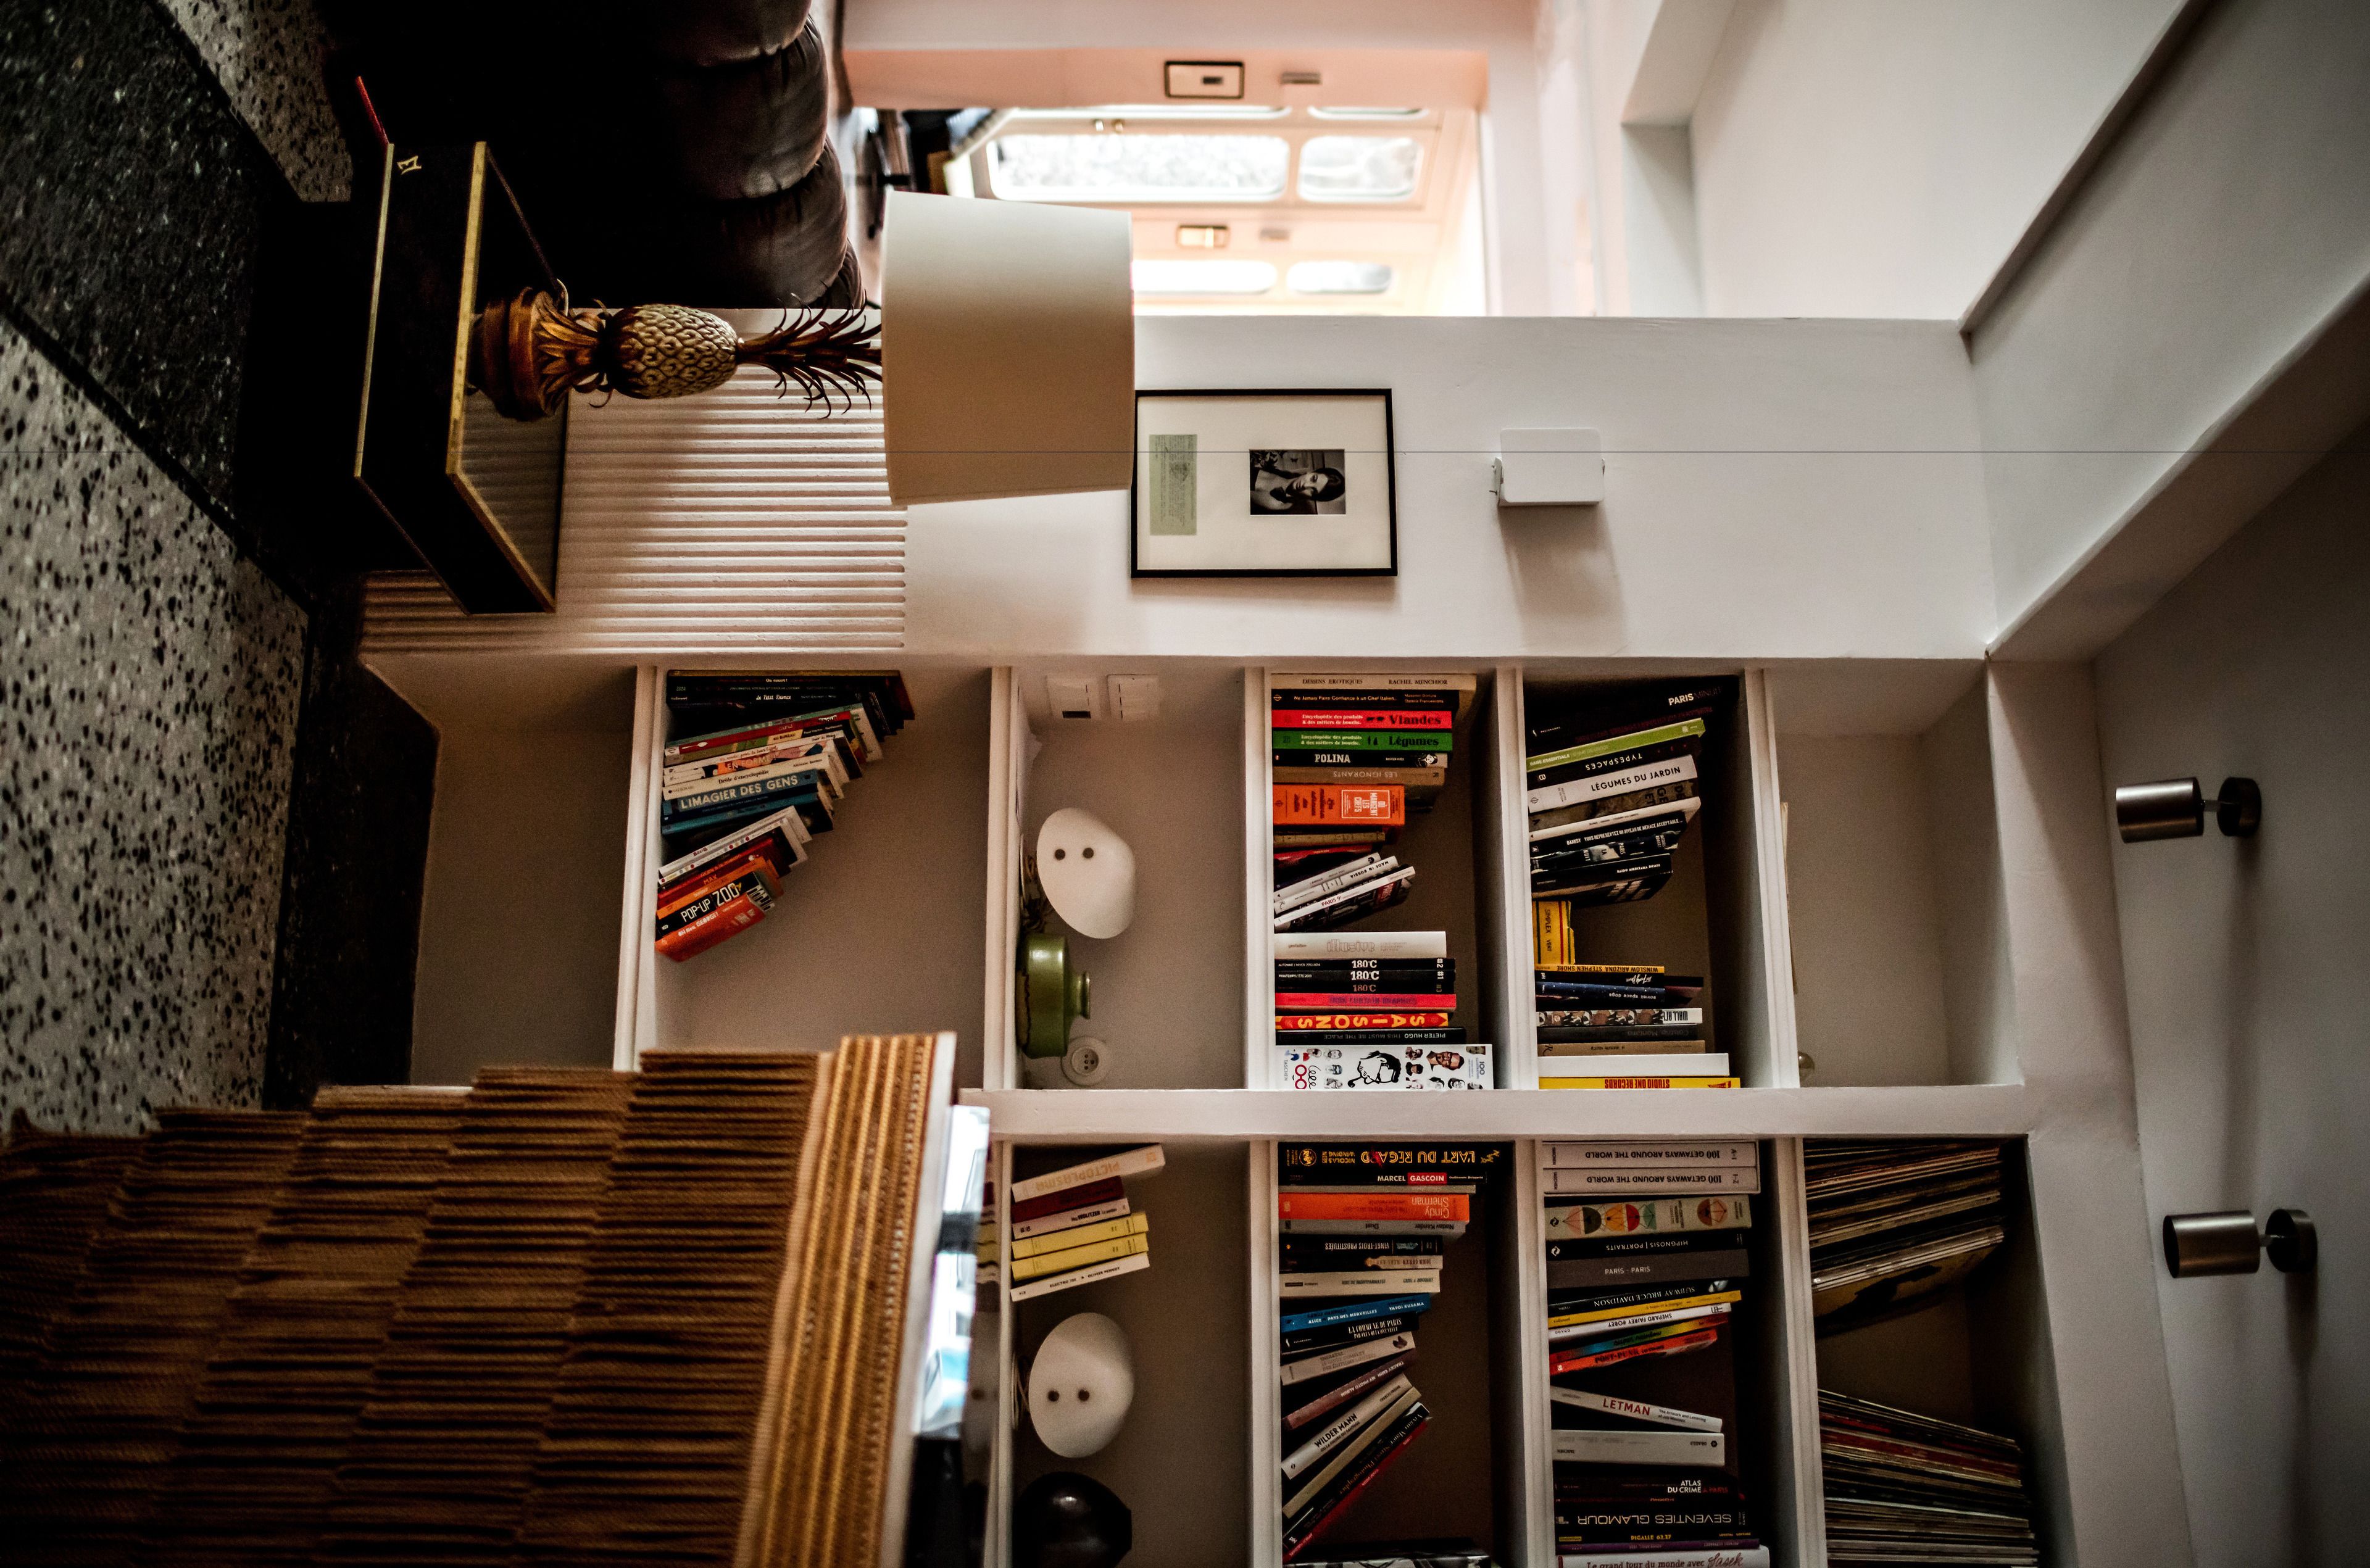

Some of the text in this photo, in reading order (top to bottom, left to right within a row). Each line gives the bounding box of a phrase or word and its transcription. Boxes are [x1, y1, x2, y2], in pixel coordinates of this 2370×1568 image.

[1668, 693, 1694, 706] PARIS
[1389, 715, 1441, 725] Viandes
[1389, 735, 1439, 748] Légumes
[1315, 754, 1350, 763] POLINA
[1585, 753, 1643, 771] TYPESPACES
[727, 761, 739, 771] EN
[1591, 766, 1681, 791] LÉGUMES DU JARDIN
[740, 783, 762, 796] DES
[767, 774, 798, 790] GENS
[1375, 860, 1389, 869] MADE
[1350, 869, 1367, 879] RUSSIA
[681, 898, 711, 922] POP-UP
[712, 882, 739, 907] ZOO
[1321, 897, 1337, 906] PARIS
[1352, 960, 1377, 968] 180°C
[1437, 958, 1444, 968] #2
[1350, 971, 1379, 981] 180°C
[1353, 984, 1376, 992] 180°C
[1297, 1014, 1425, 1029] SAISONS
[1605, 1079, 1669, 1089] STUDIO ONE RECORDS
[1417, 1151, 1437, 1163] DU
[1441, 1151, 1475, 1163] L'ART
[1707, 1150, 1720, 1158] 100
[1708, 1175, 1722, 1184] 100
[1412, 1197, 1449, 1205] Sherman
[1424, 1208, 1449, 1218] Cindy
[1359, 1242, 1389, 1250] VINGT-TROIS
[1650, 1240, 1688, 1248] HIPGNOSIS
[1637, 1290, 1663, 1301] BRUCE
[1664, 1287, 1695, 1297] SUBWAY
[1594, 1293, 1635, 1307] DAVIDSON
[1379, 1320, 1386, 1328] DE
[1387, 1317, 1402, 1327] PARIS
[1628, 1317, 1647, 1325] FAIREY
[1647, 1313, 1672, 1322] SHEPARD
[1603, 1398, 1650, 1416] LETMAN
[1314, 1413, 1357, 1448] WILDER MANN
[1578, 1514, 1732, 1525] SEVENTIES GLAMOUR
[1599, 1560, 1624, 1568] grand
[1626, 1560, 1643, 1568] tour
[1646, 1559, 1655, 1568] du
[1658, 1559, 1679, 1568] monde
